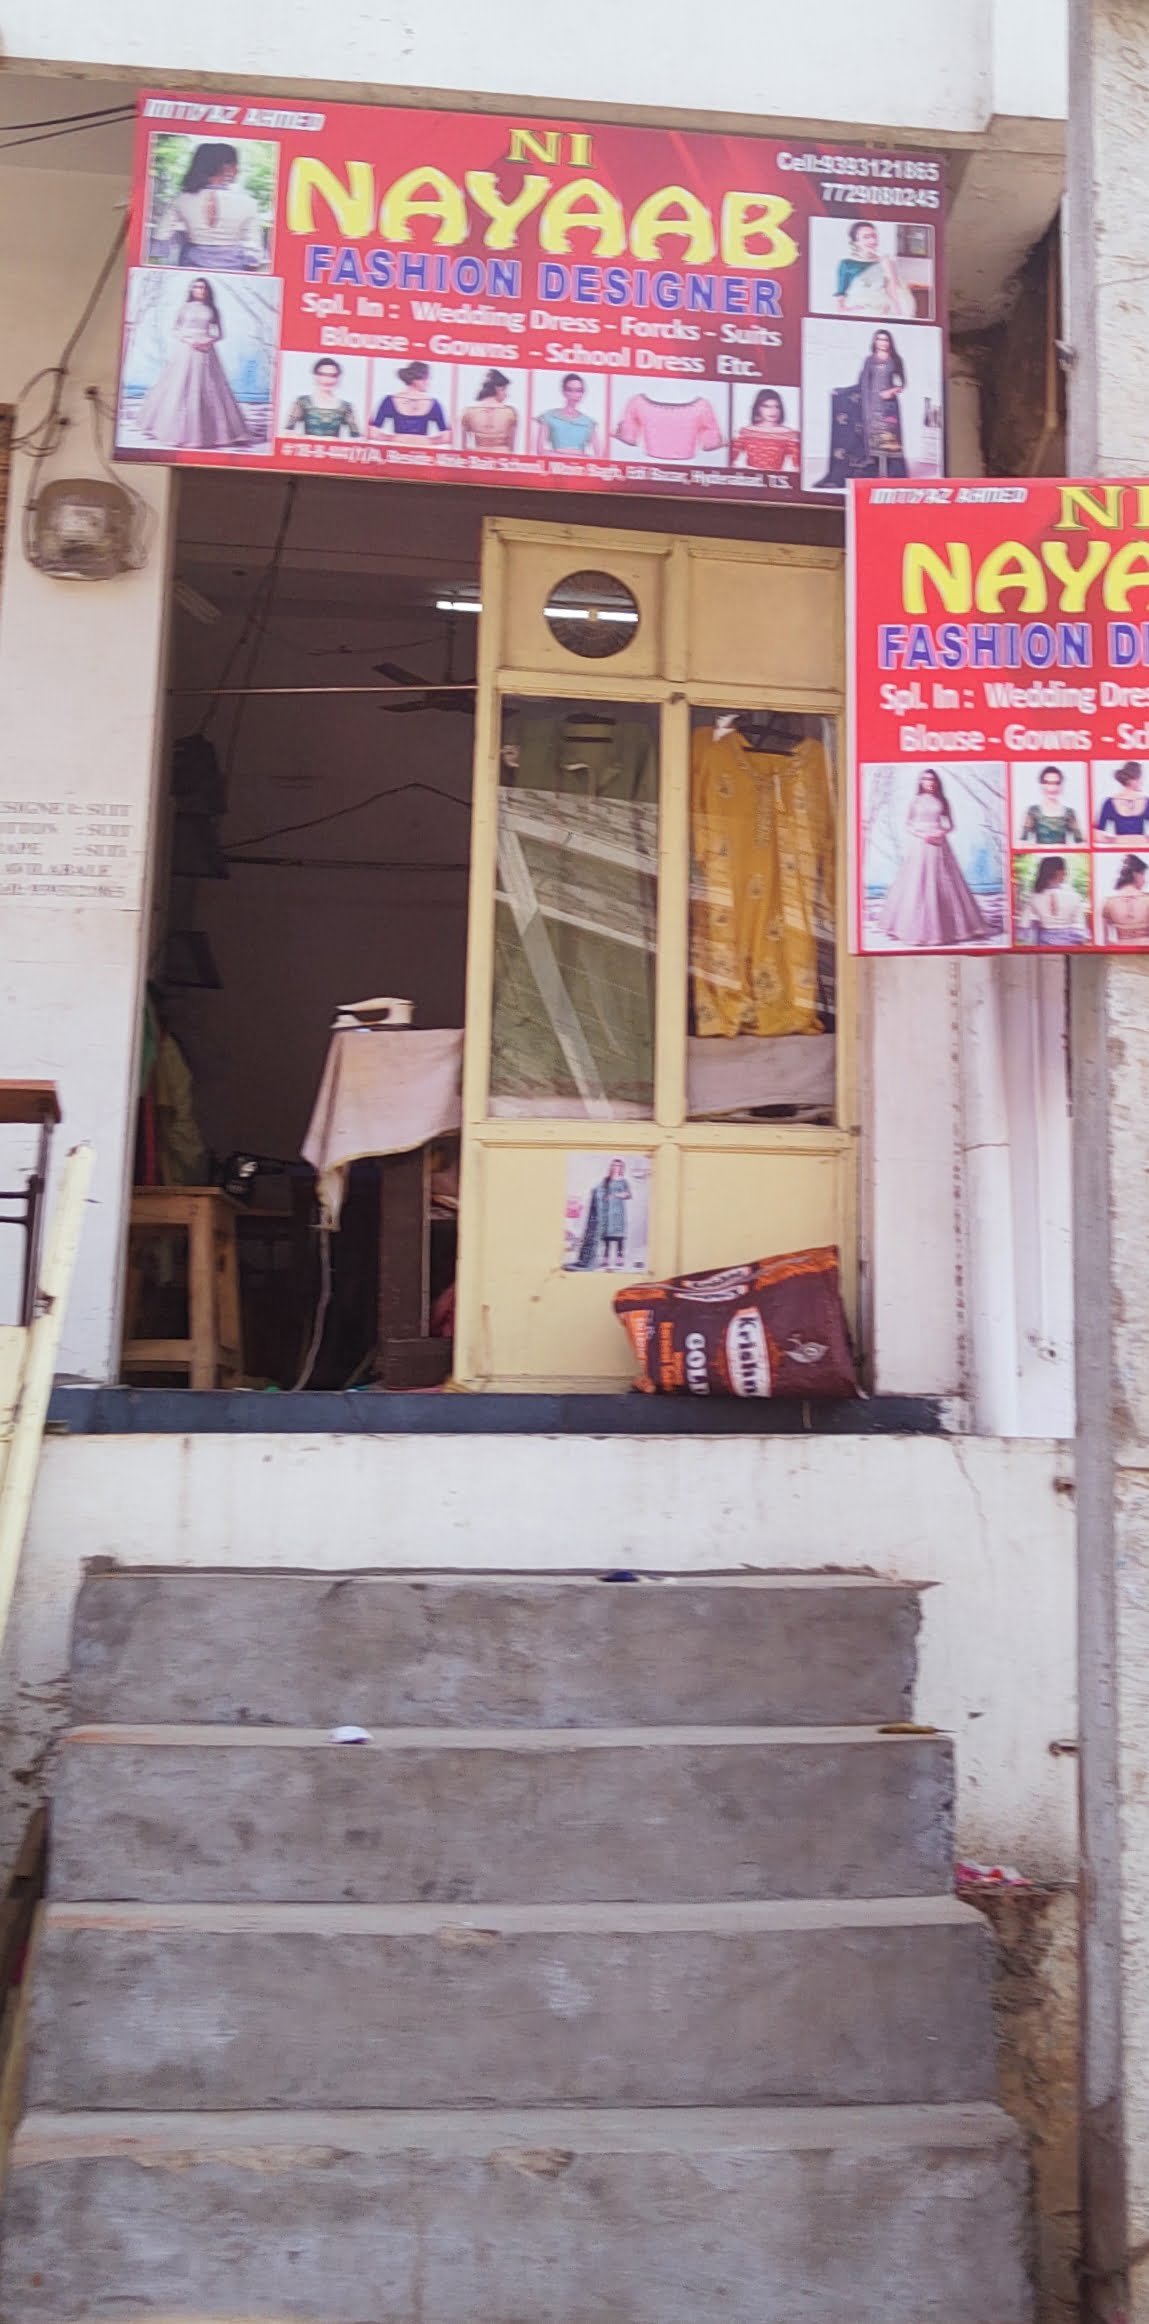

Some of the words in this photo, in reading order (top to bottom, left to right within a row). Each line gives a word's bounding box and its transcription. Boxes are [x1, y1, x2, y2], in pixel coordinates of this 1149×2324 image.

[506, 128, 596, 168] NI
[287, 156, 800, 270] NAYAAB
[305, 245, 522, 300] FASHION
[537, 261, 784, 318] DESIGNER
[301, 291, 350, 320] Spl.
[411, 300, 526, 334] Wedding
[530, 308, 602, 335] Dress
[621, 316, 702, 342] Forcks
[719, 322, 783, 347] Suits
[319, 325, 409, 354] Blouse
[429, 333, 520, 361] Gowns
[545, 342, 631, 369] School
[635, 348, 706, 374] Dress
[716, 354, 763, 377] Etc.
[878, 622, 1092, 670] FASHION
[880, 683, 928, 713] Spl.
[984, 680, 1096, 714] Wedding
[900, 725, 986, 752] Blouse
[1004, 724, 1092, 752] Gowns
